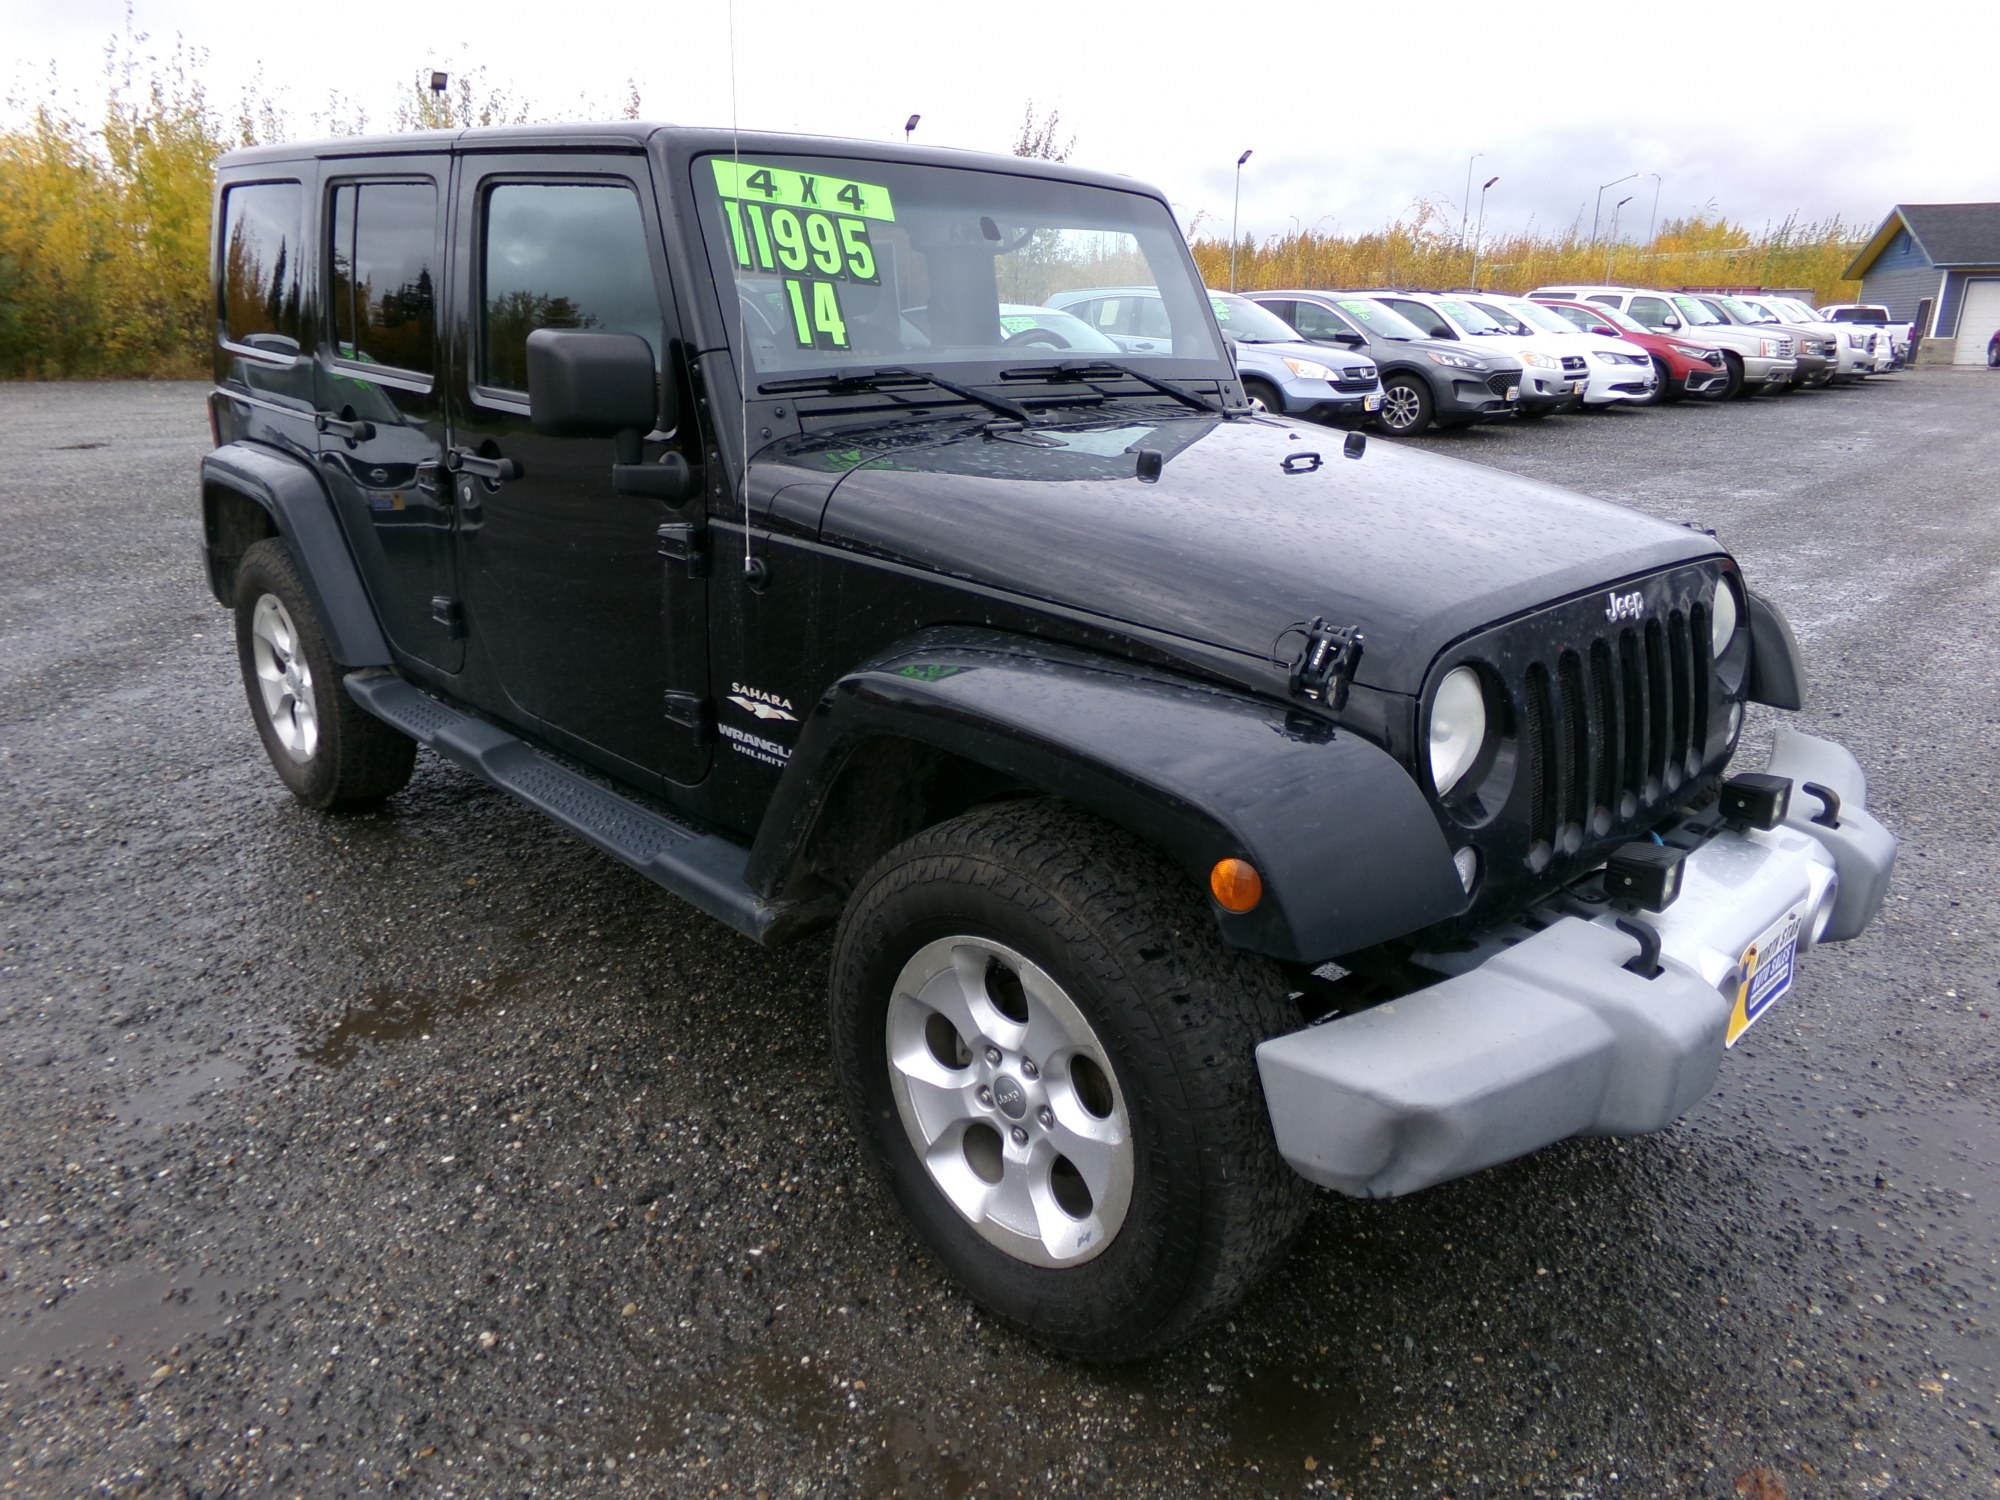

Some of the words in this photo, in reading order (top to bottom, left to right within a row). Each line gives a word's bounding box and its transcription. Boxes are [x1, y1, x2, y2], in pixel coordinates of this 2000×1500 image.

[746, 169, 778, 198] 4
[837, 184, 866, 212] 4
[724, 200, 875, 279] 11995
[786, 279, 846, 345] 14
[1605, 591, 1643, 622] Jeep
[731, 682, 793, 710] SAHARA
[732, 743, 787, 768] UNLIMIT
